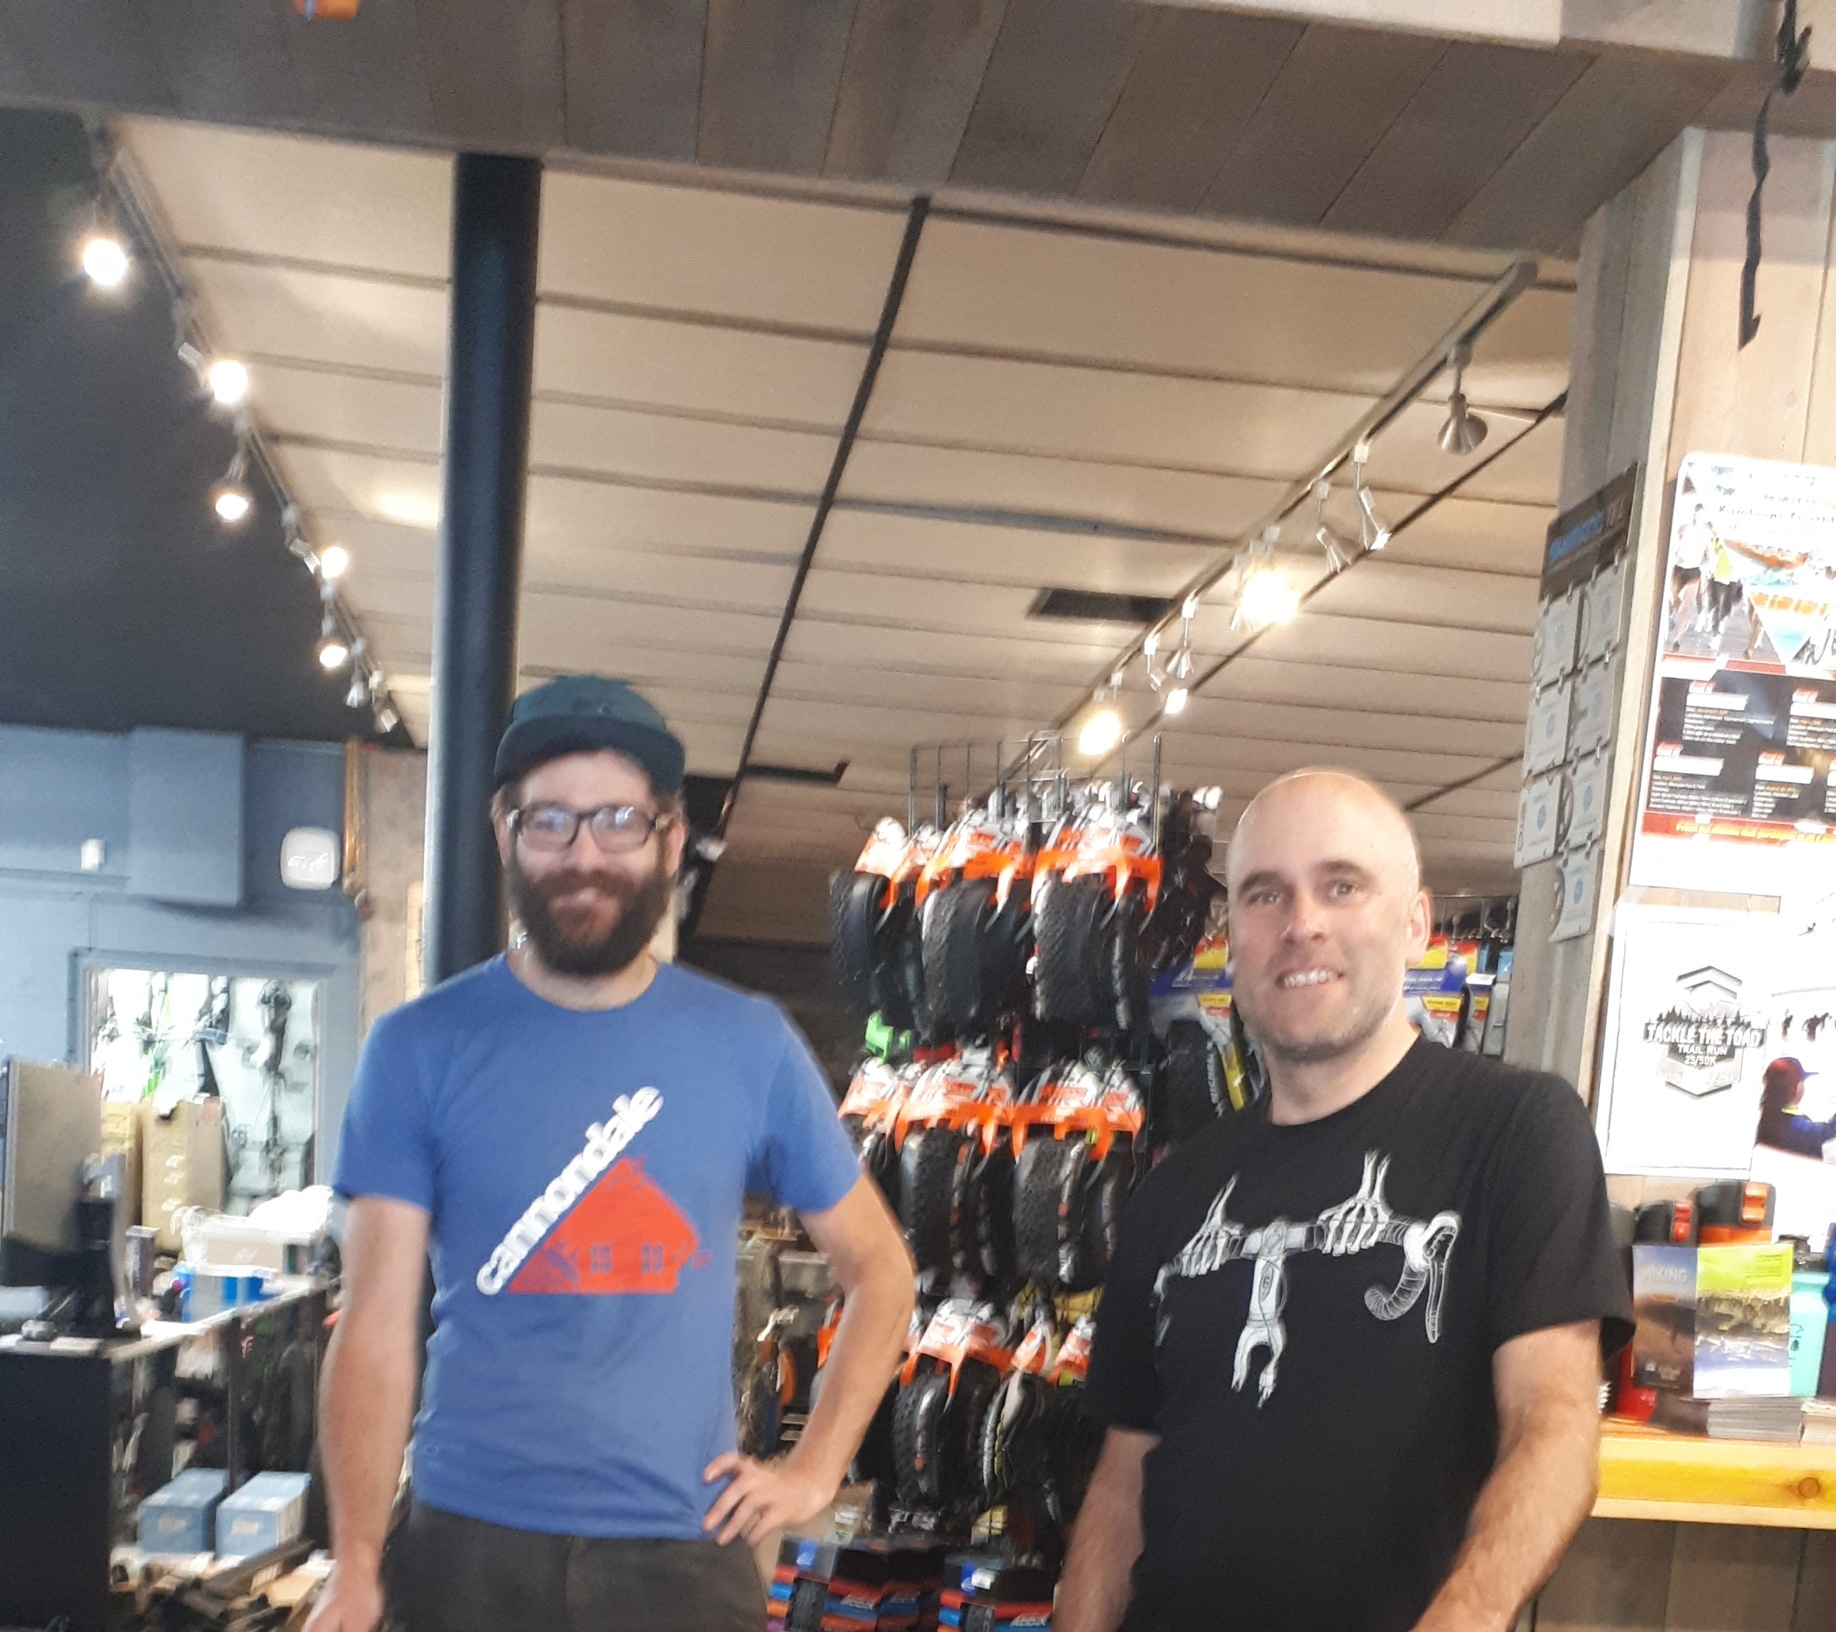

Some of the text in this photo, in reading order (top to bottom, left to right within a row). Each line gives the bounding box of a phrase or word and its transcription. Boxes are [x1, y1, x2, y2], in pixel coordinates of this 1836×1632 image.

[1646, 1021, 1761, 1047] TACKLE THE TOAD
[1677, 1044, 1729, 1056] TRAIL RUN
[476, 1086, 664, 1296] cannondale
